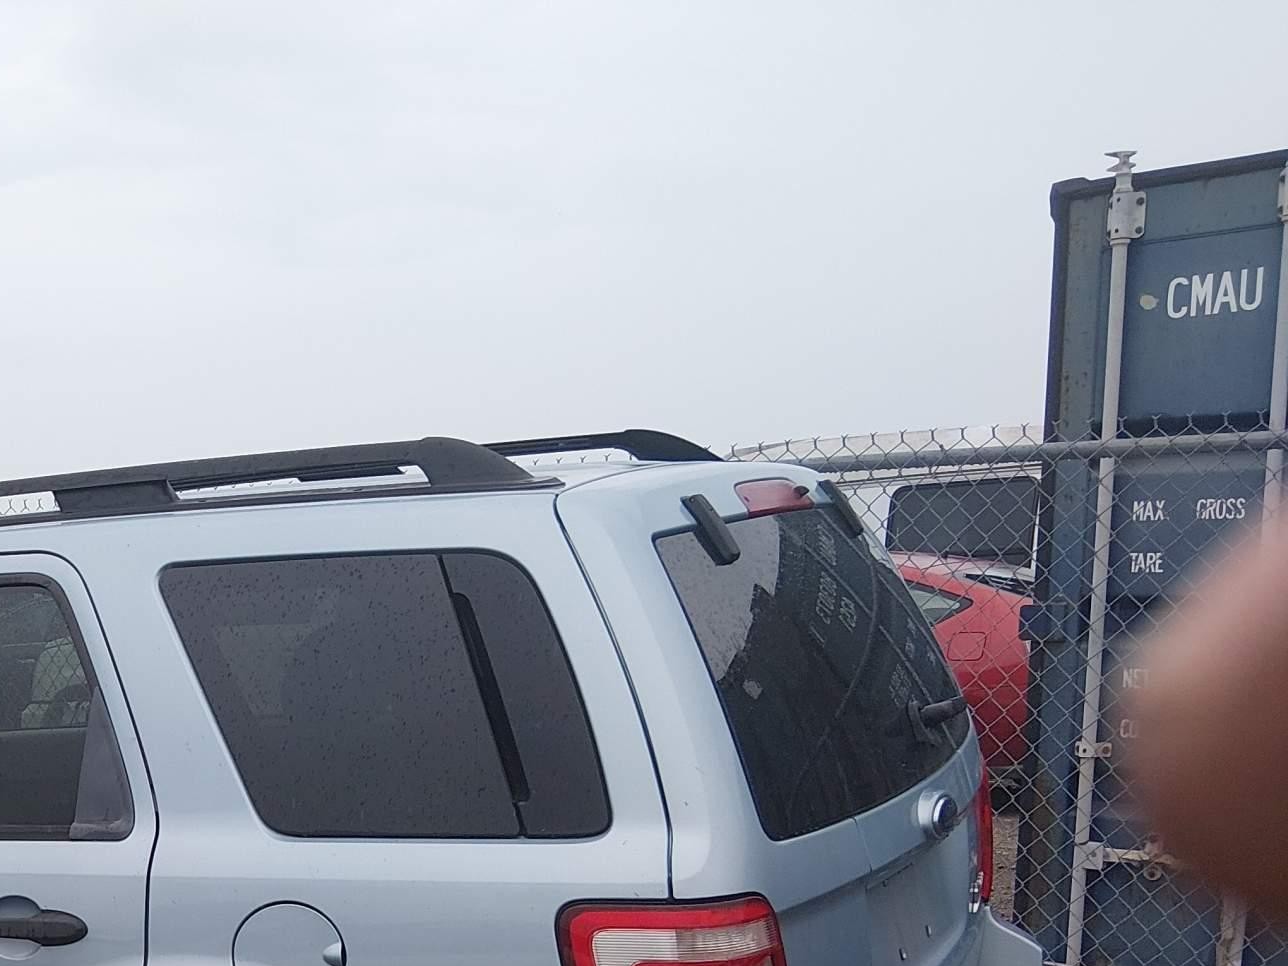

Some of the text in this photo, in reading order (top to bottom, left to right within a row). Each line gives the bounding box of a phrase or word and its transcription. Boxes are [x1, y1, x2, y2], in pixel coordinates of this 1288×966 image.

[1167, 266, 1265, 319] CMAU
[1196, 498, 1246, 520] GROSS
[1130, 553, 1164, 573] TARE
